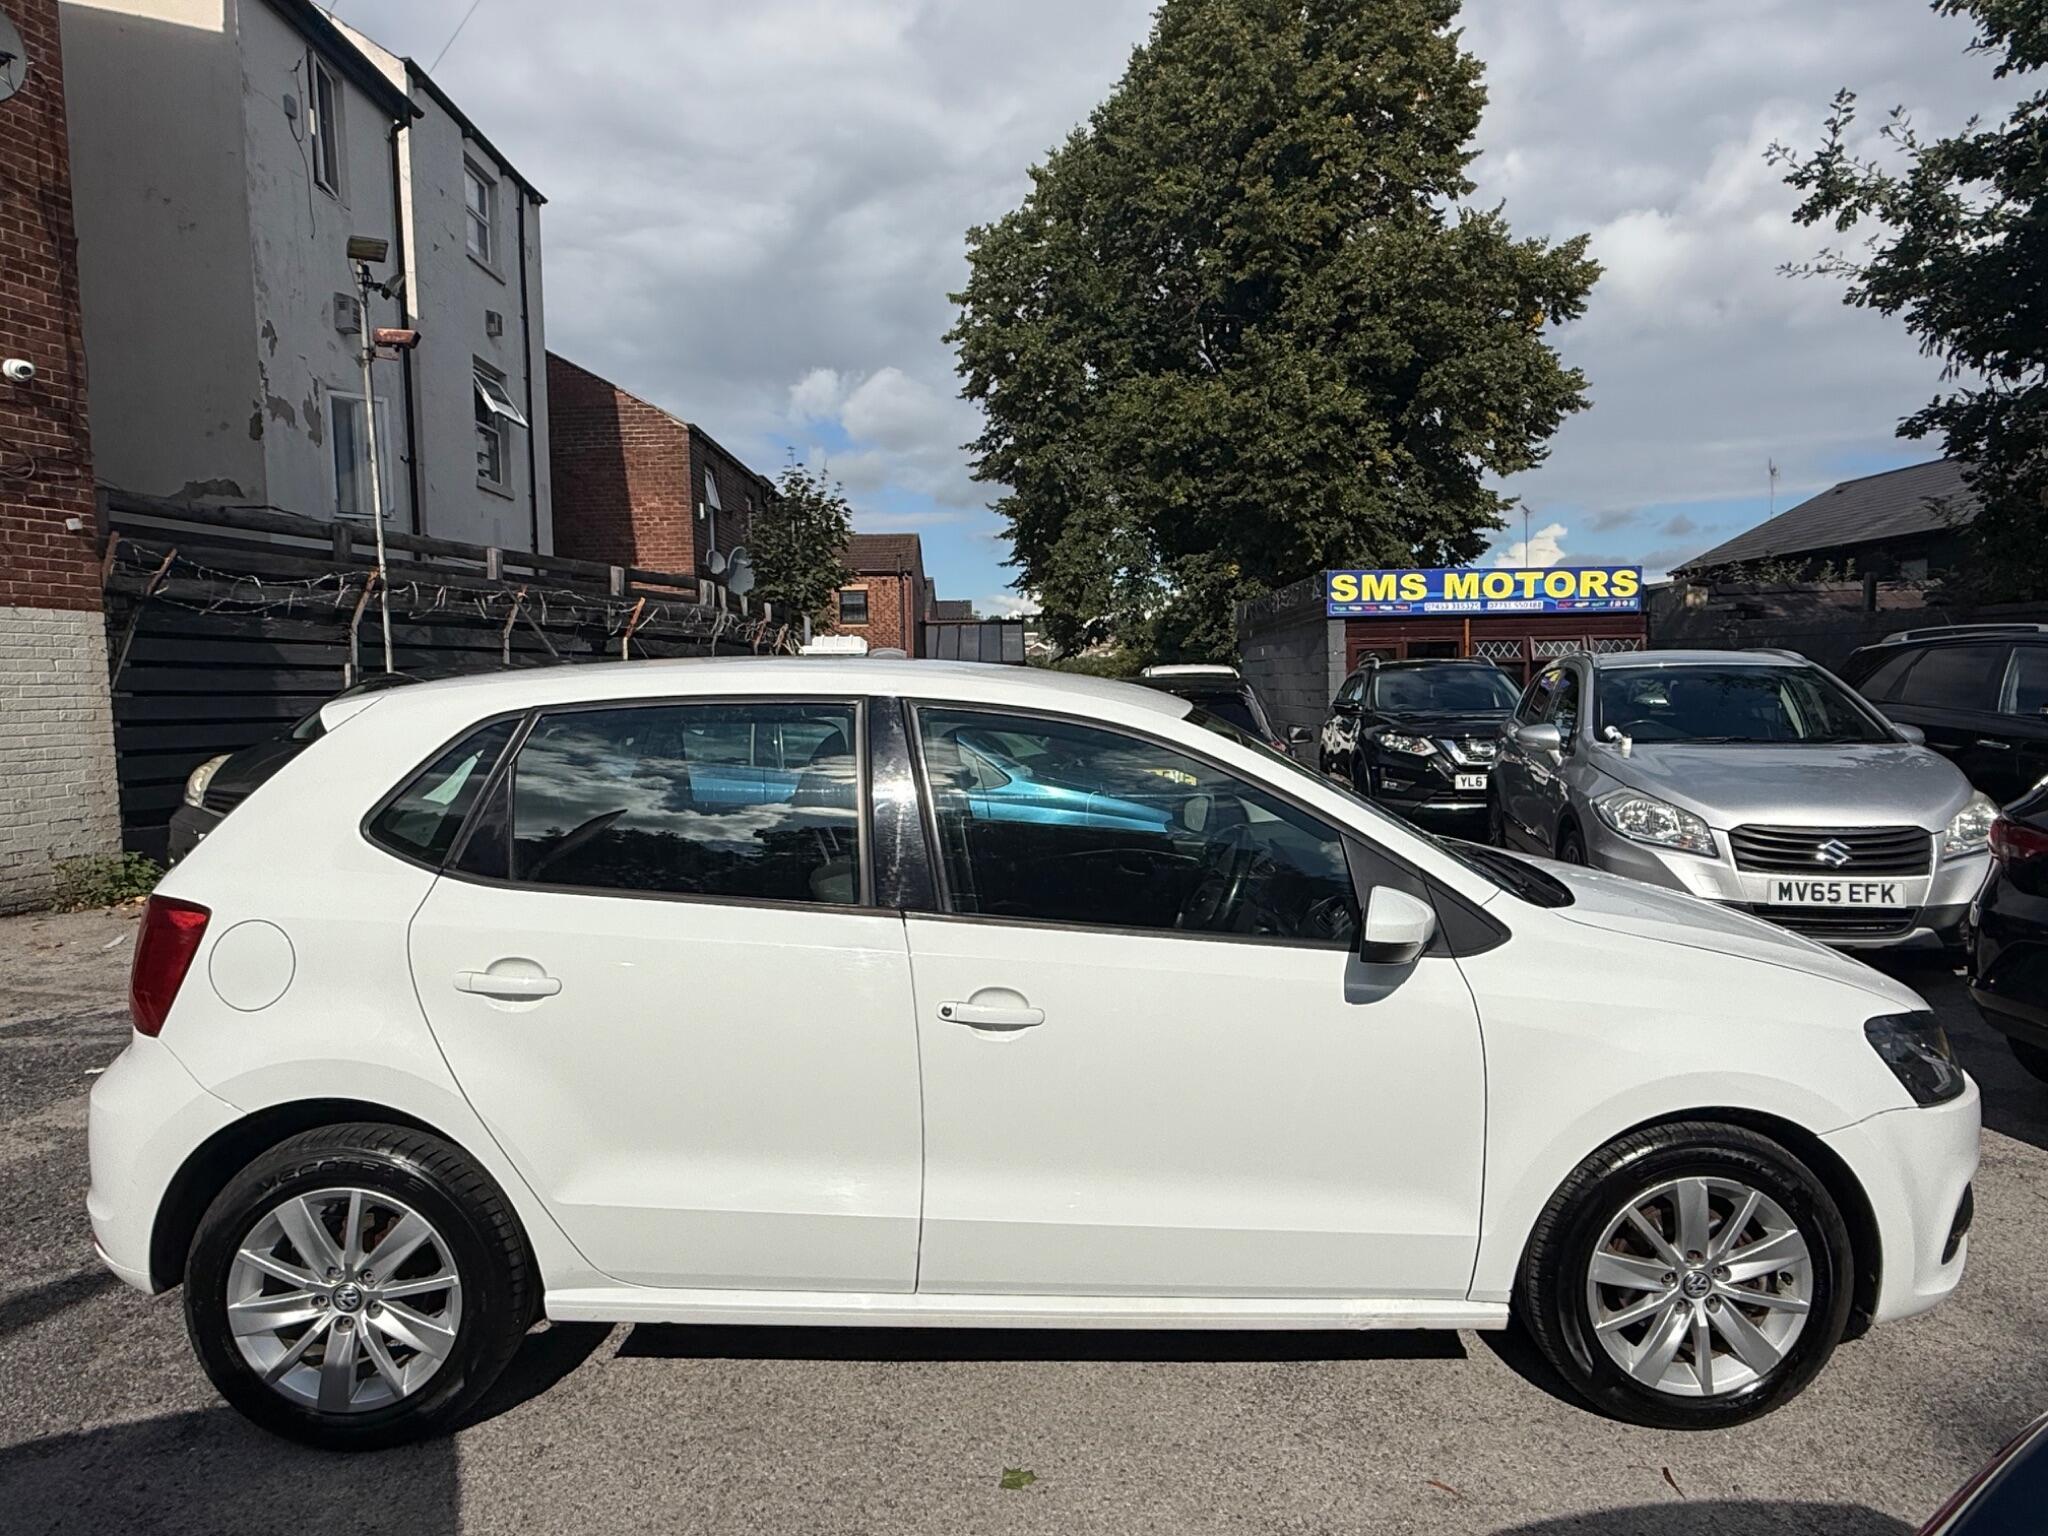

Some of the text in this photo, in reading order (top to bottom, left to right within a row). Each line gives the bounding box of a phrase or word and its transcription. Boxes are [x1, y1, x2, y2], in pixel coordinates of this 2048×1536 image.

[1331, 570, 1639, 601] SMS MOTORS
[1461, 776, 1488, 787] YL6
[1778, 882, 1896, 904] MV65 EFK
